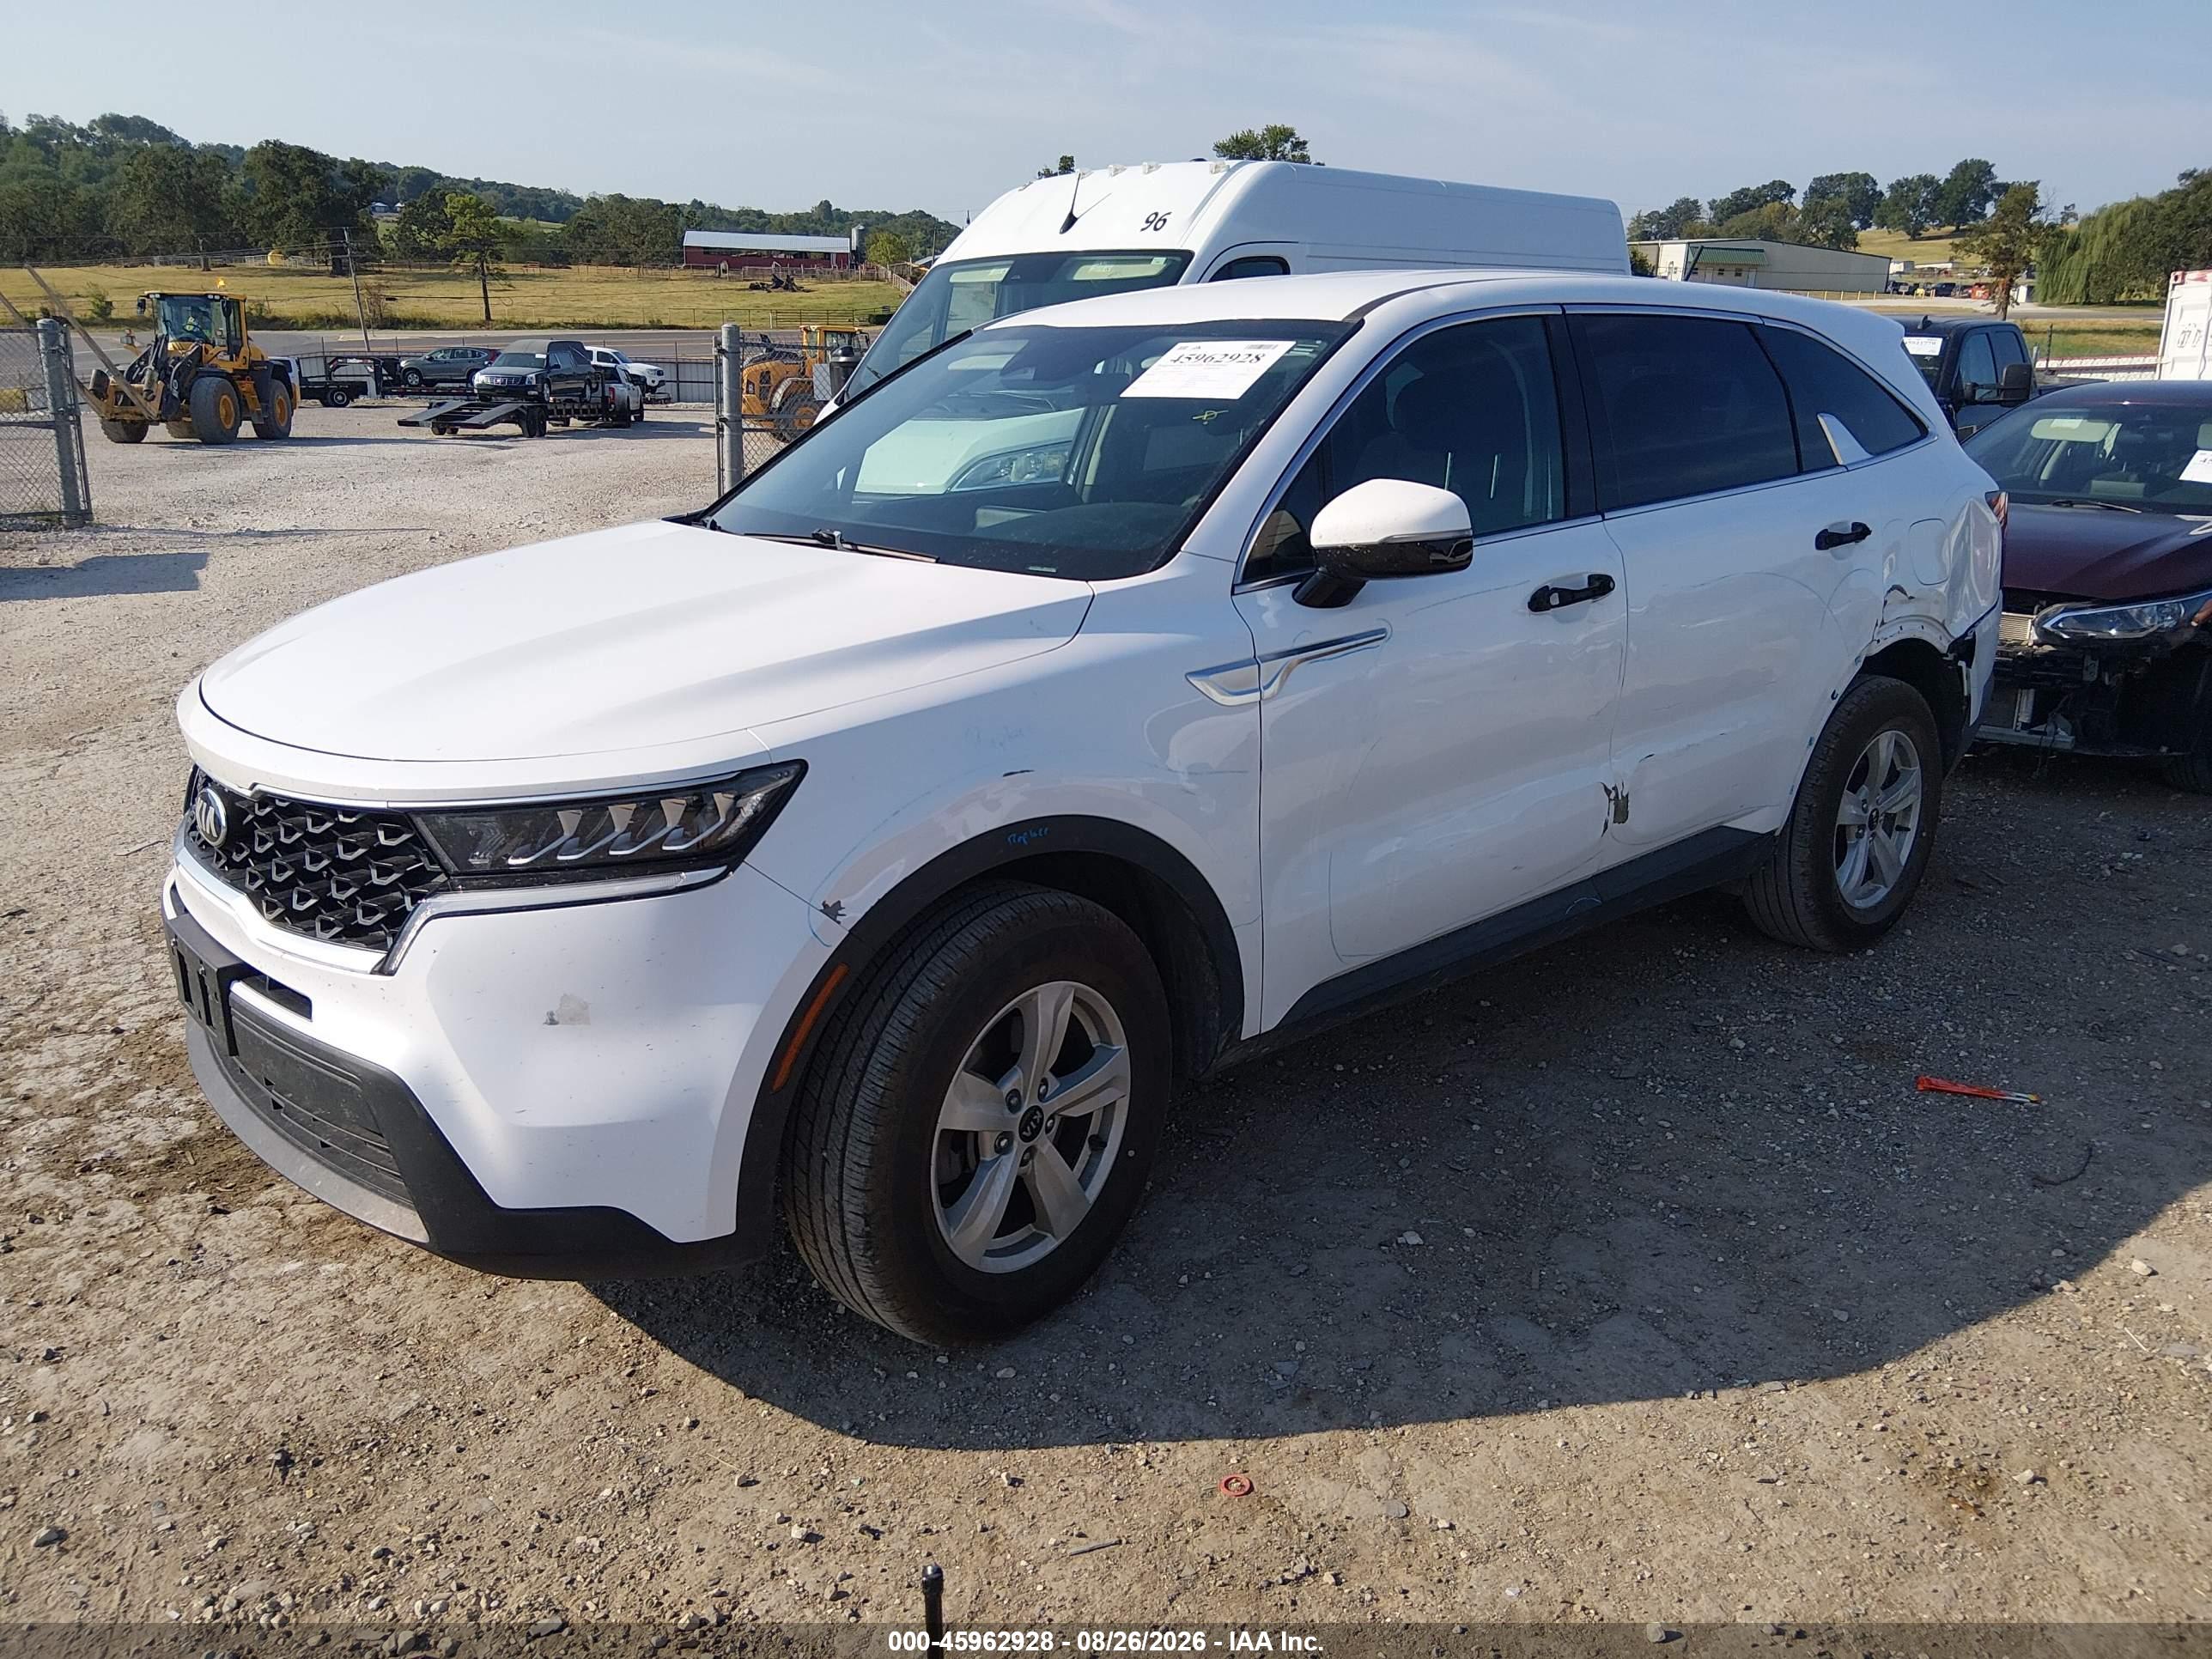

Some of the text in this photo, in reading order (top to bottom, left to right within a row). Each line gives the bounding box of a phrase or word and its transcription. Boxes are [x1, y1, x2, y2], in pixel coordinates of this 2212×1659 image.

[1139, 211, 1172, 232] 96
[1170, 353, 1266, 364] 45962928
[196, 796, 218, 838] KIA
